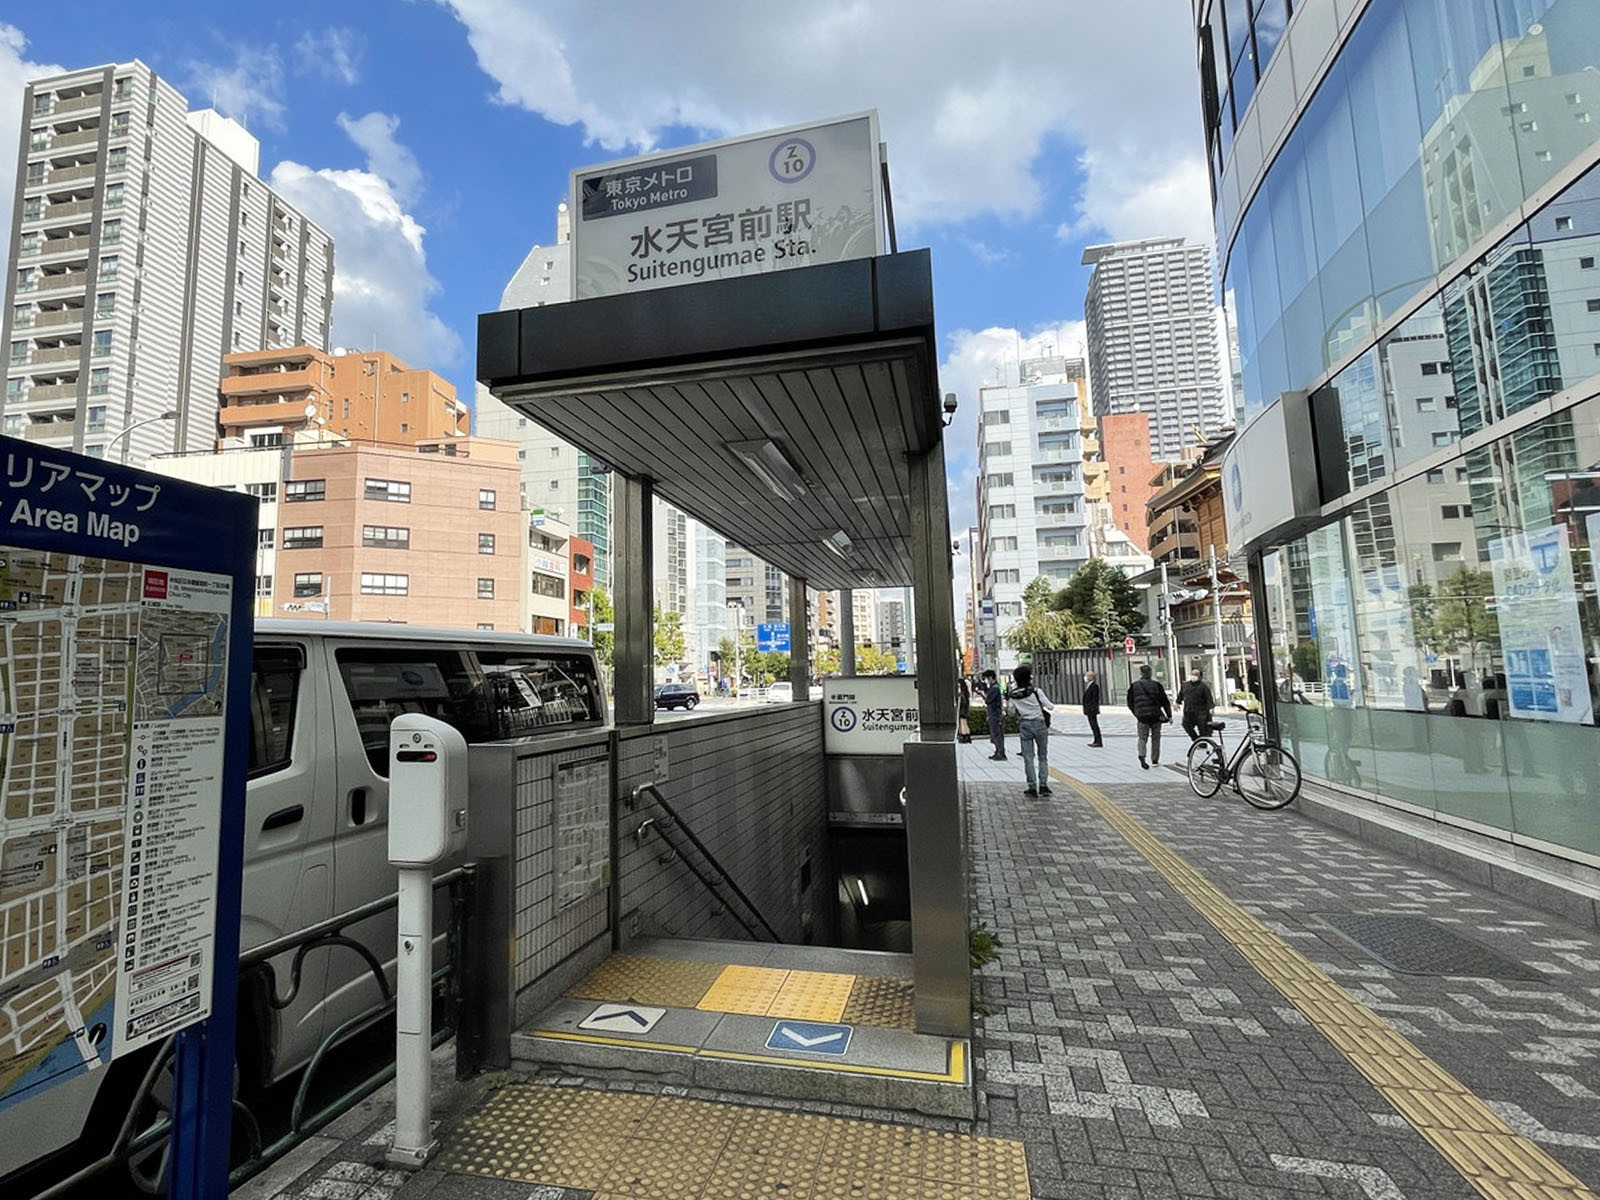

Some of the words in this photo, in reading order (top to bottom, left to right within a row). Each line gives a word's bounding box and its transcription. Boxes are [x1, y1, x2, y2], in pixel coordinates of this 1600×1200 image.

[786, 145, 798, 158] Z
[783, 159, 804, 174] 10
[605, 167, 693, 197] 東京メトロ
[611, 193, 646, 212] Tokyo
[649, 185, 689, 203] Metro
[630, 198, 812, 259] 水天宮前駅
[626, 245, 765, 283] Suitengumae
[774, 237, 816, 260] Sta.
[10, 498, 79, 534] Area
[86, 510, 141, 548] Map
[838, 718, 851, 727] 10
